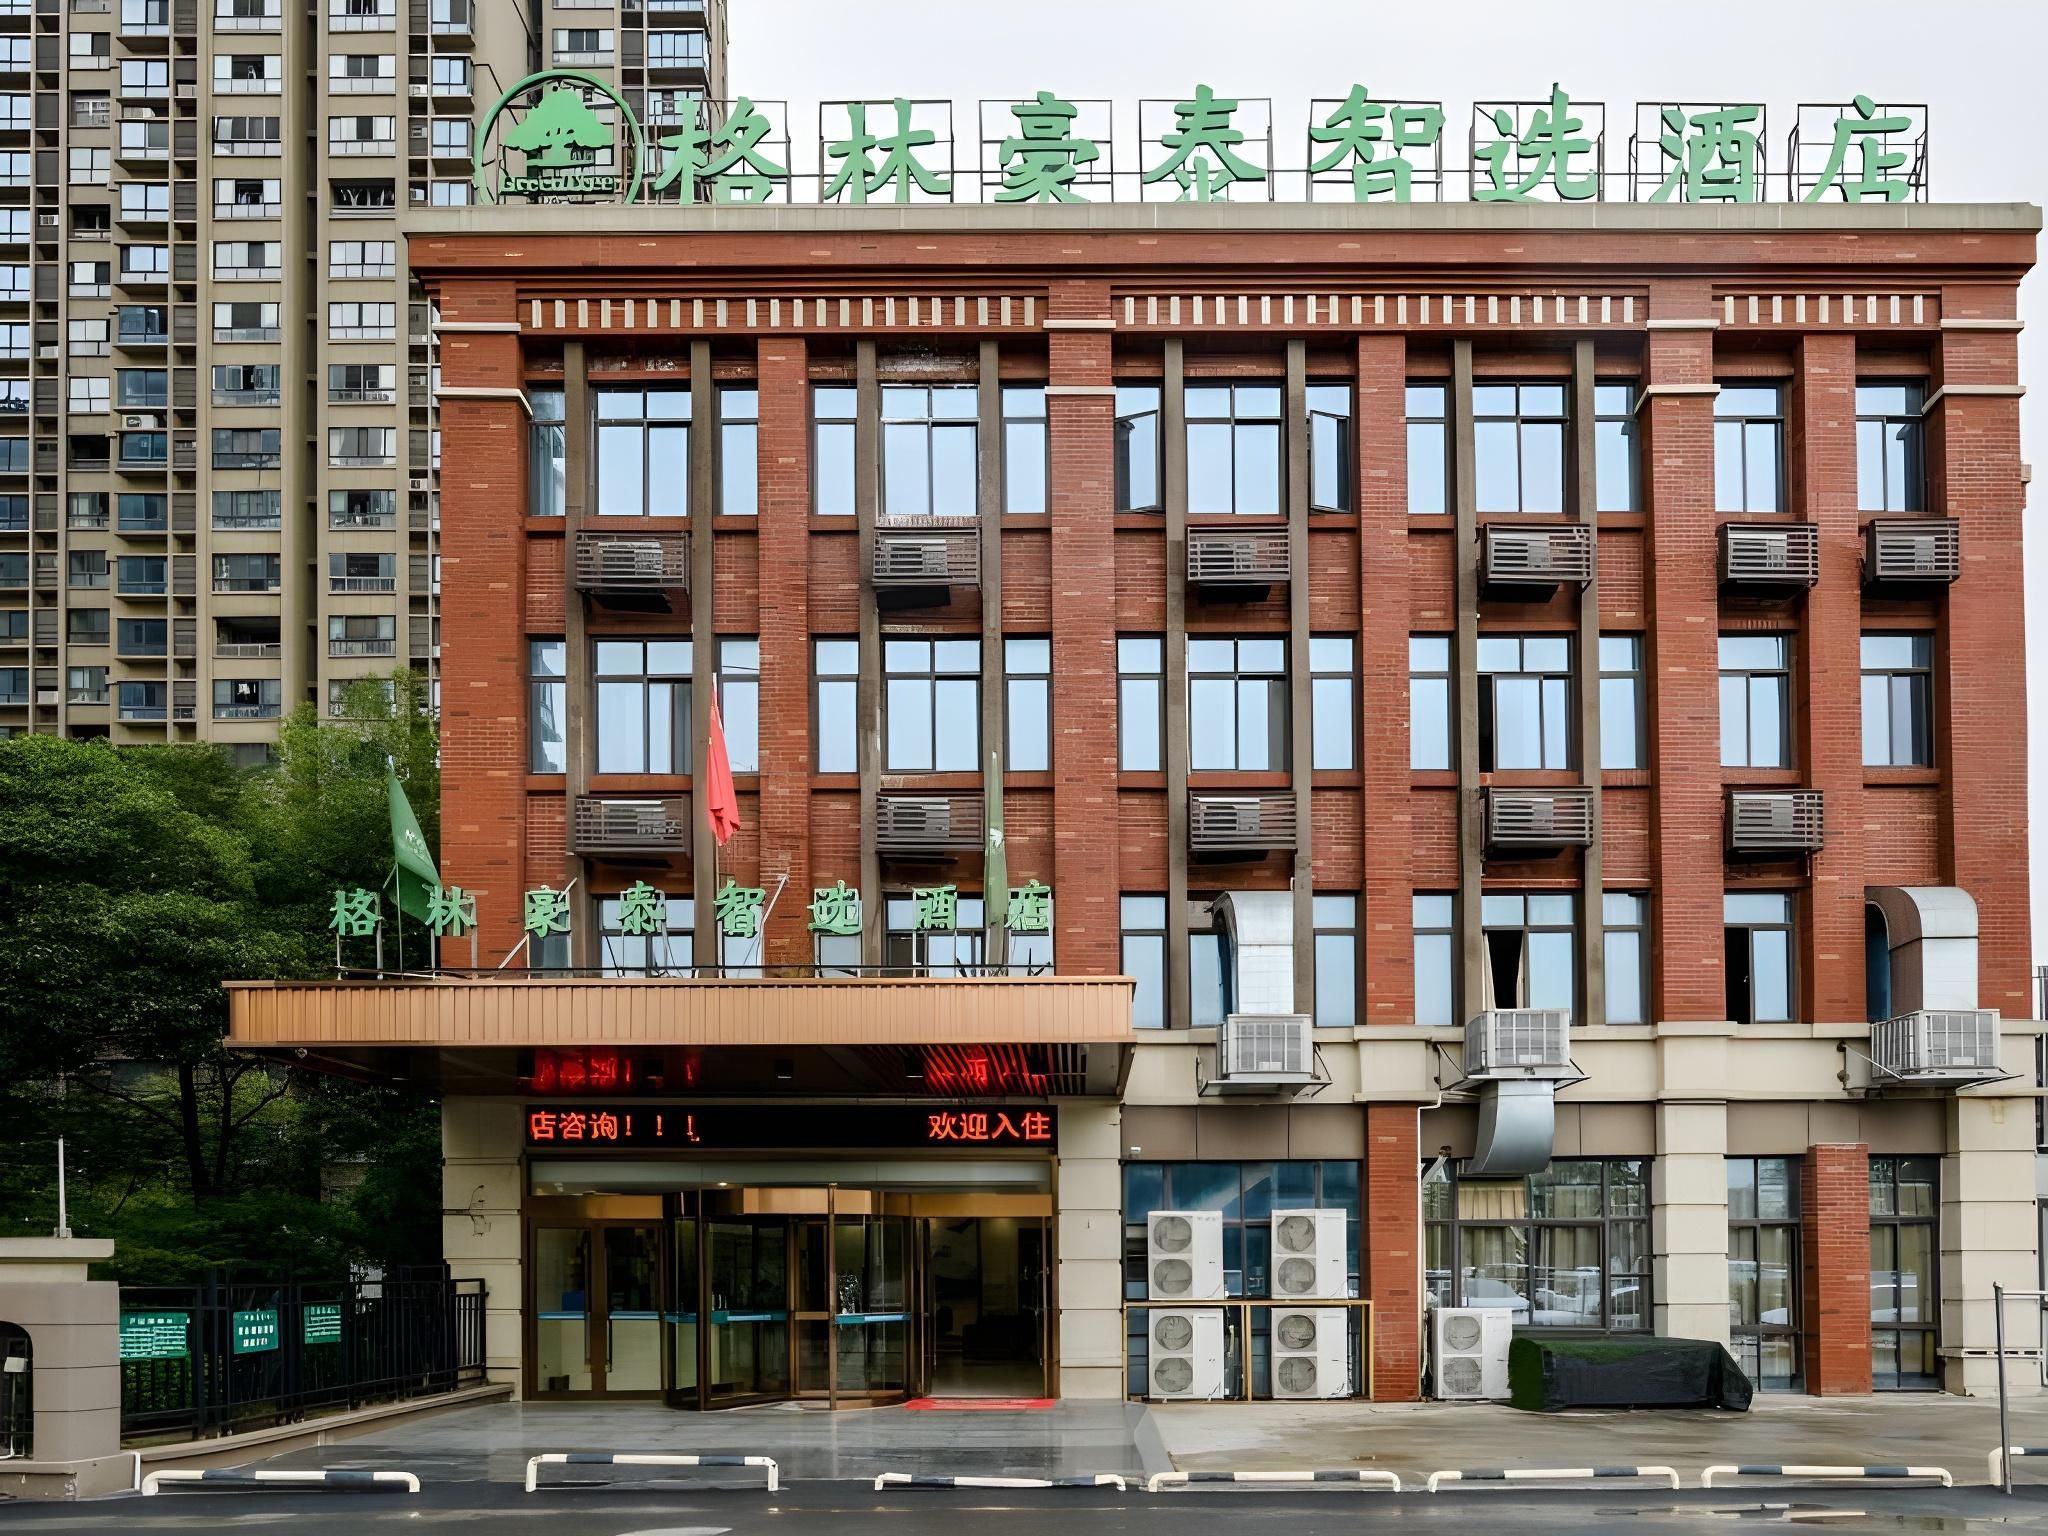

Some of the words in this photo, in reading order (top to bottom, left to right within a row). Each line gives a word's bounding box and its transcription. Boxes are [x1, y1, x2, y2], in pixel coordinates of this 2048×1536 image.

[653, 84, 1912, 204] 格林豪泰智选酒店
[329, 879, 1051, 938] 格林豪泰智选酒店
[928, 1111, 1052, 1140] 欢迎入住
